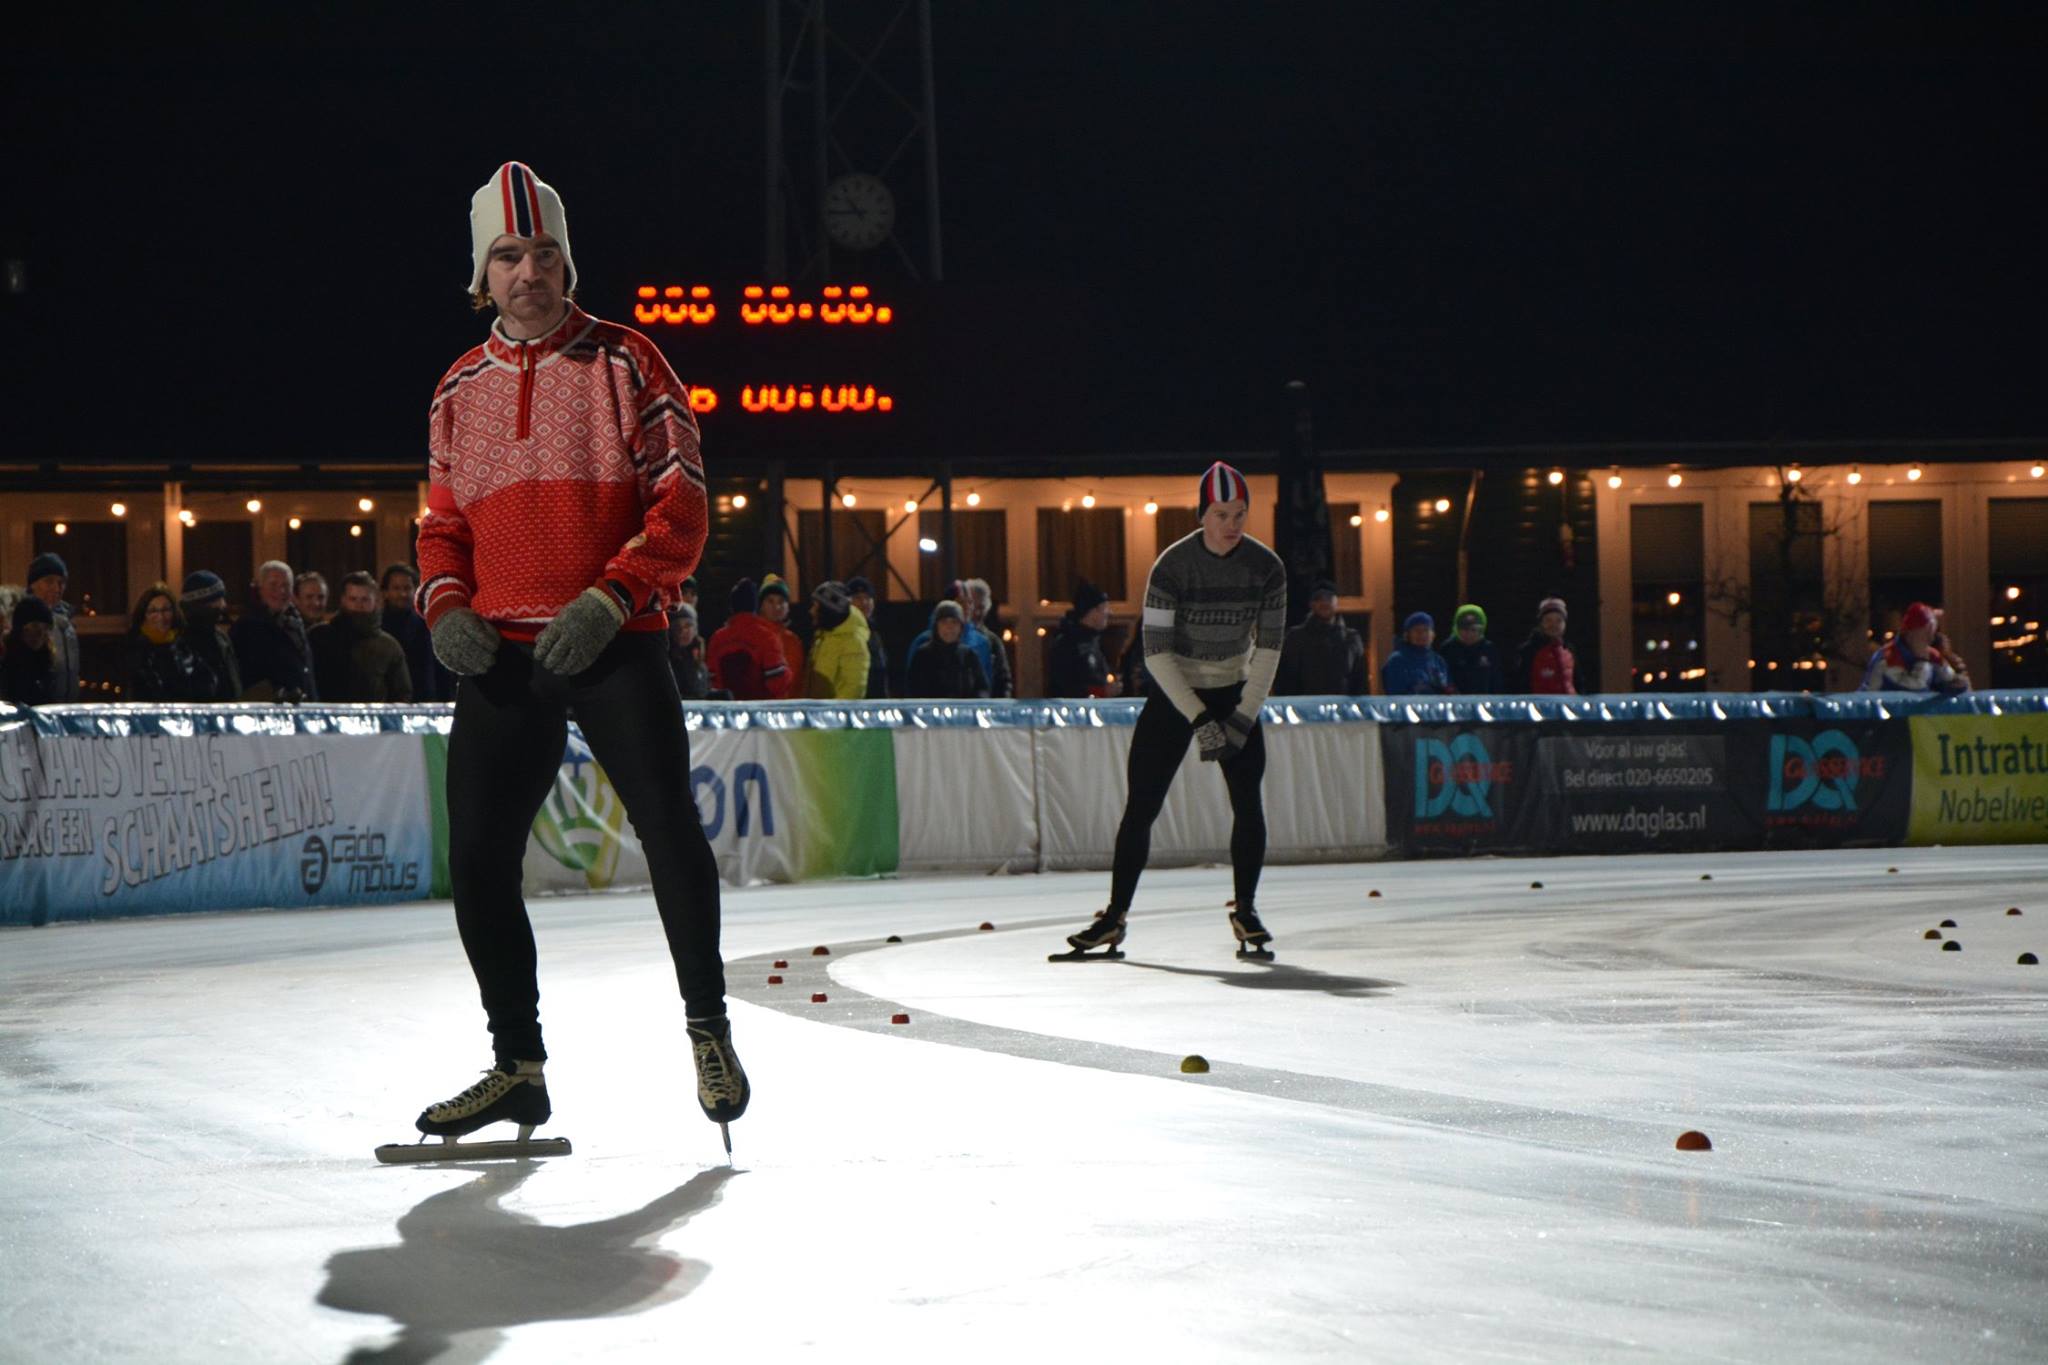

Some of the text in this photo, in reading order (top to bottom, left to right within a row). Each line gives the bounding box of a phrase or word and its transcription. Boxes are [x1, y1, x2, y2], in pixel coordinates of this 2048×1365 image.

[1584, 738, 1615, 759] Voor
[1617, 737, 1631, 758] al
[1633, 742, 1654, 758] uw
[1564, 768, 1585, 787] Bel
[1587, 768, 1625, 787] direct
[57, 808, 95, 857] EEN
[102, 751, 336, 897] SCHAATSHELM!
[1571, 804, 1707, 839] www.dqglas.nl
